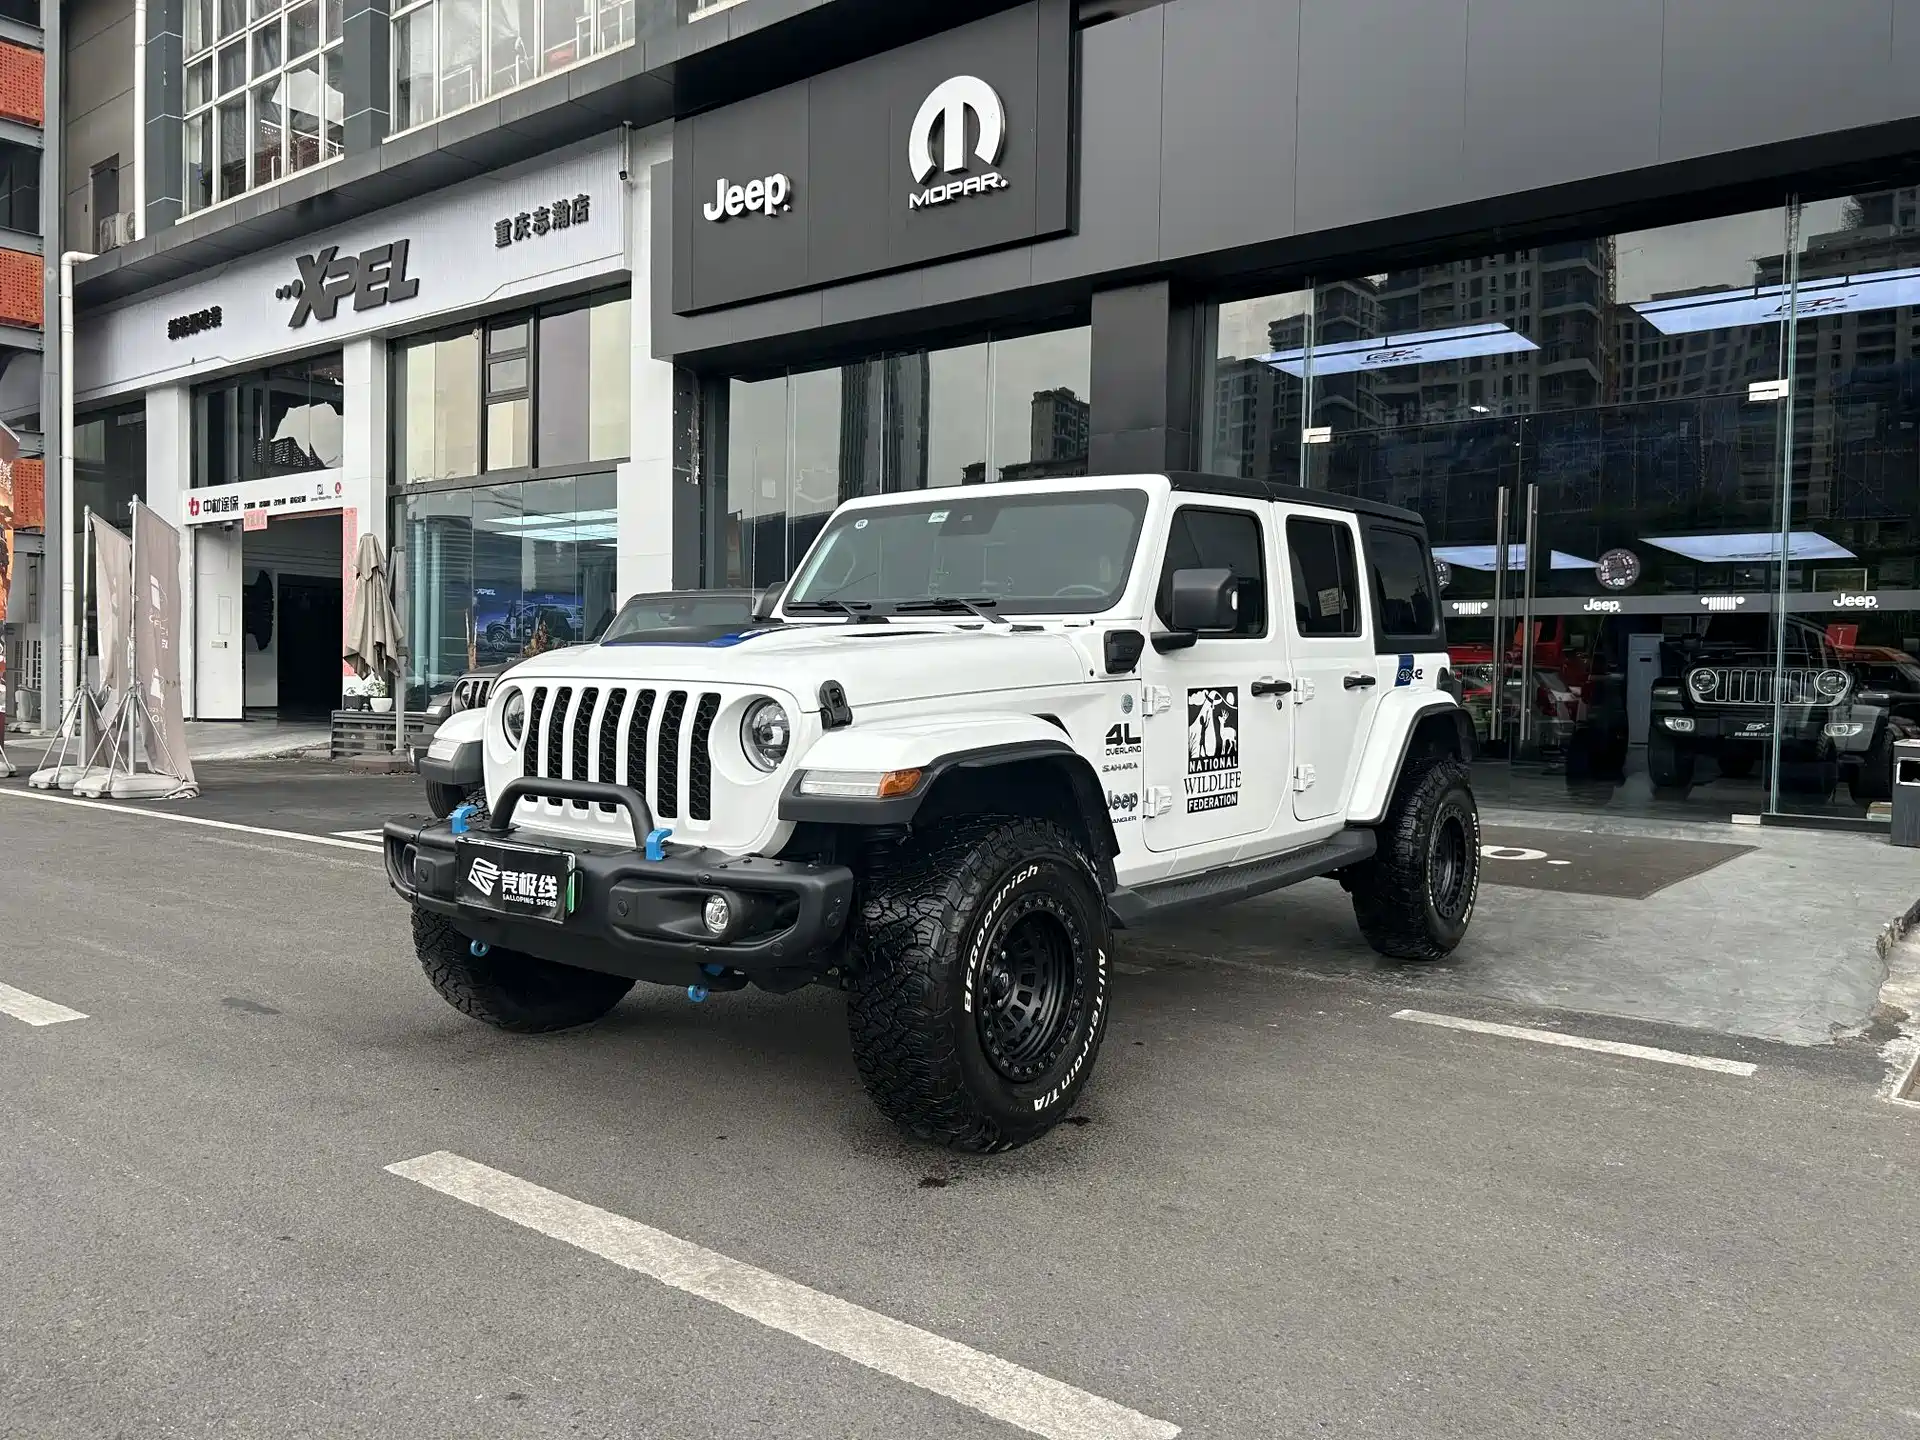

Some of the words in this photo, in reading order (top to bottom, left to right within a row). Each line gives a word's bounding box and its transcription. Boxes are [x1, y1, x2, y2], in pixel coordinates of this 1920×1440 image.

[494, 193, 590, 249] 重庆志瀚店
[288, 238, 419, 328] XPEL
[1105, 723, 1142, 746] 4L
[1105, 745, 1142, 756] OVERLAND
[1102, 762, 1139, 773] SAHARA
[1189, 756, 1238, 773] NATIONAL
[1184, 771, 1242, 796] WILDLIFE
[1188, 794, 1237, 812] FEDERATION
[964, 864, 1038, 1013] BFGoodrich
[1033, 1088, 1060, 1111] T/A
